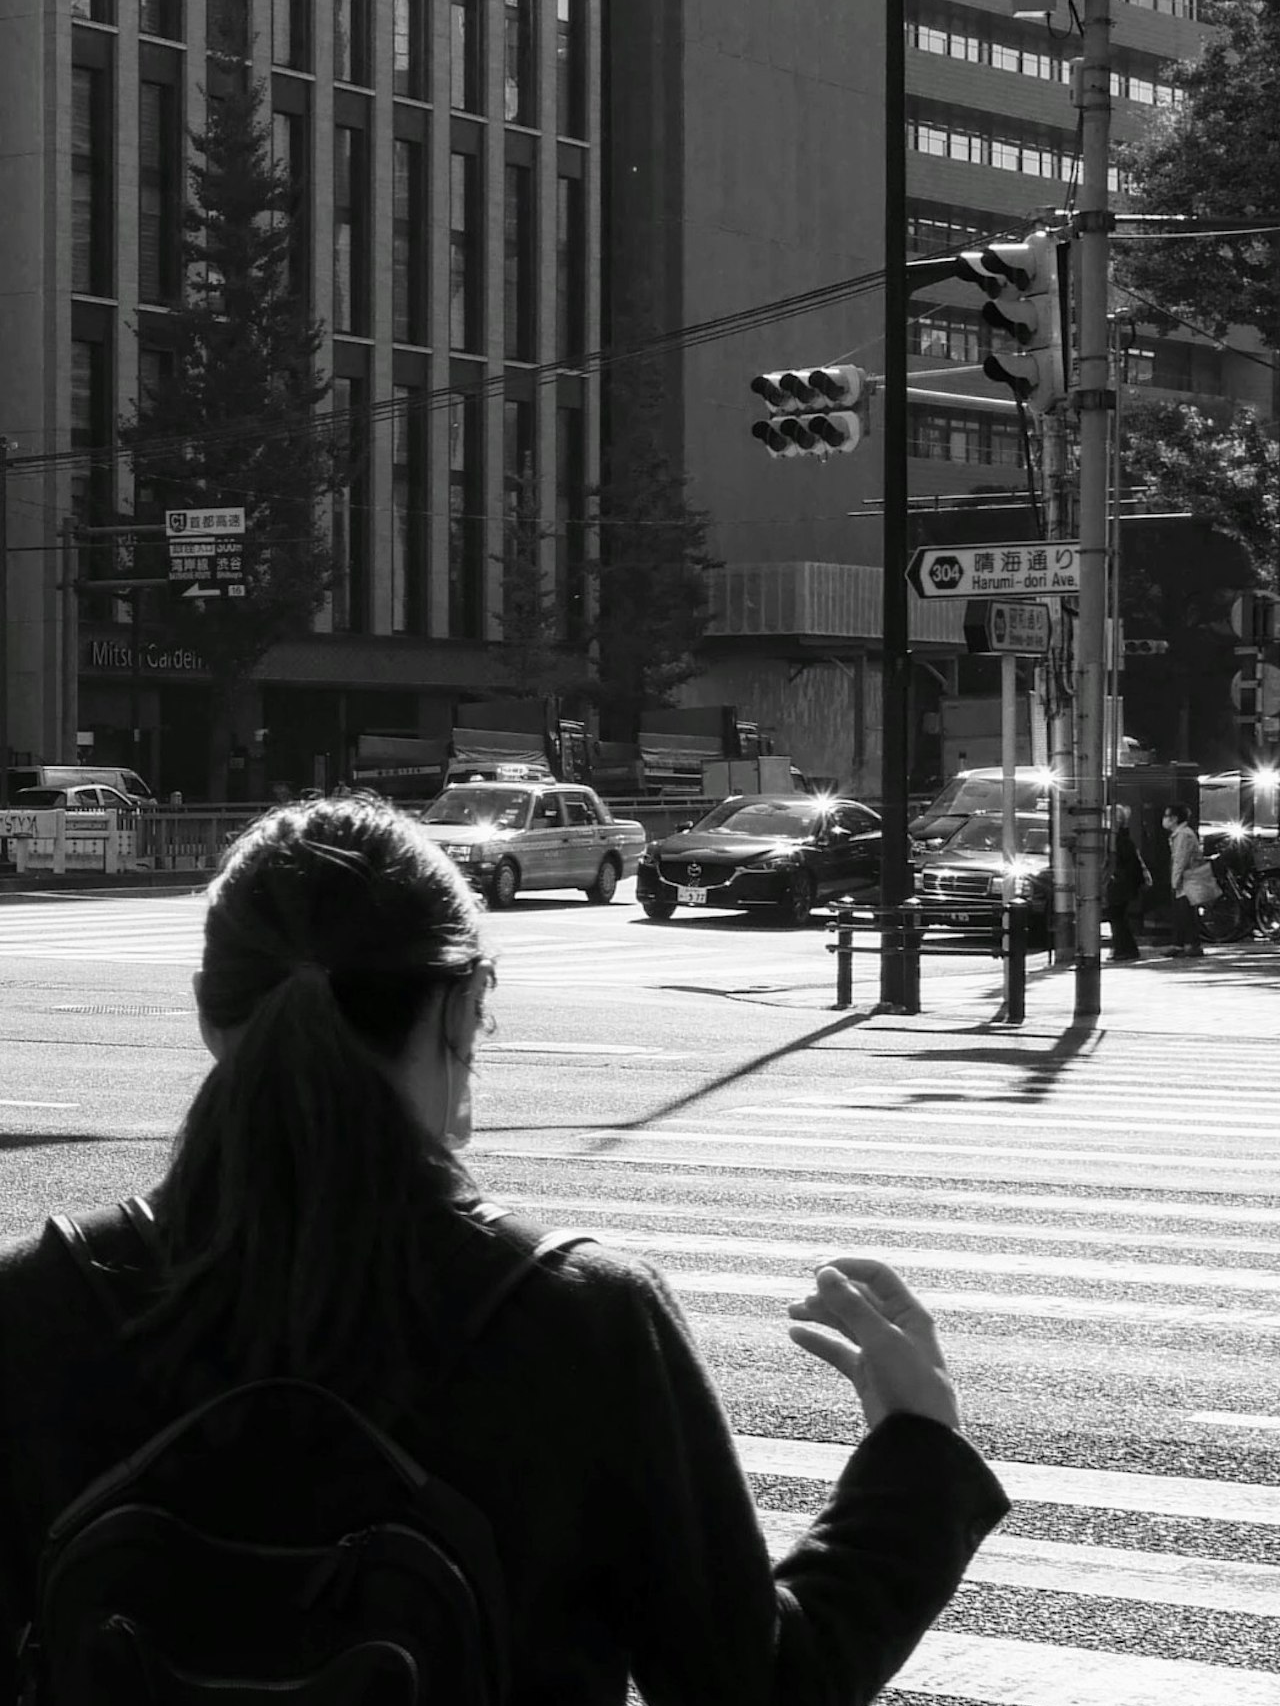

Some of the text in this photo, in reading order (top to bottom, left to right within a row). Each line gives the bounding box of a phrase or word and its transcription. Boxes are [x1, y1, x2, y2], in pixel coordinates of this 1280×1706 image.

[973, 549, 1054, 574] 晴海通り
[932, 564, 961, 582] 304
[971, 572, 1078, 591] Harumi-dori Ave.
